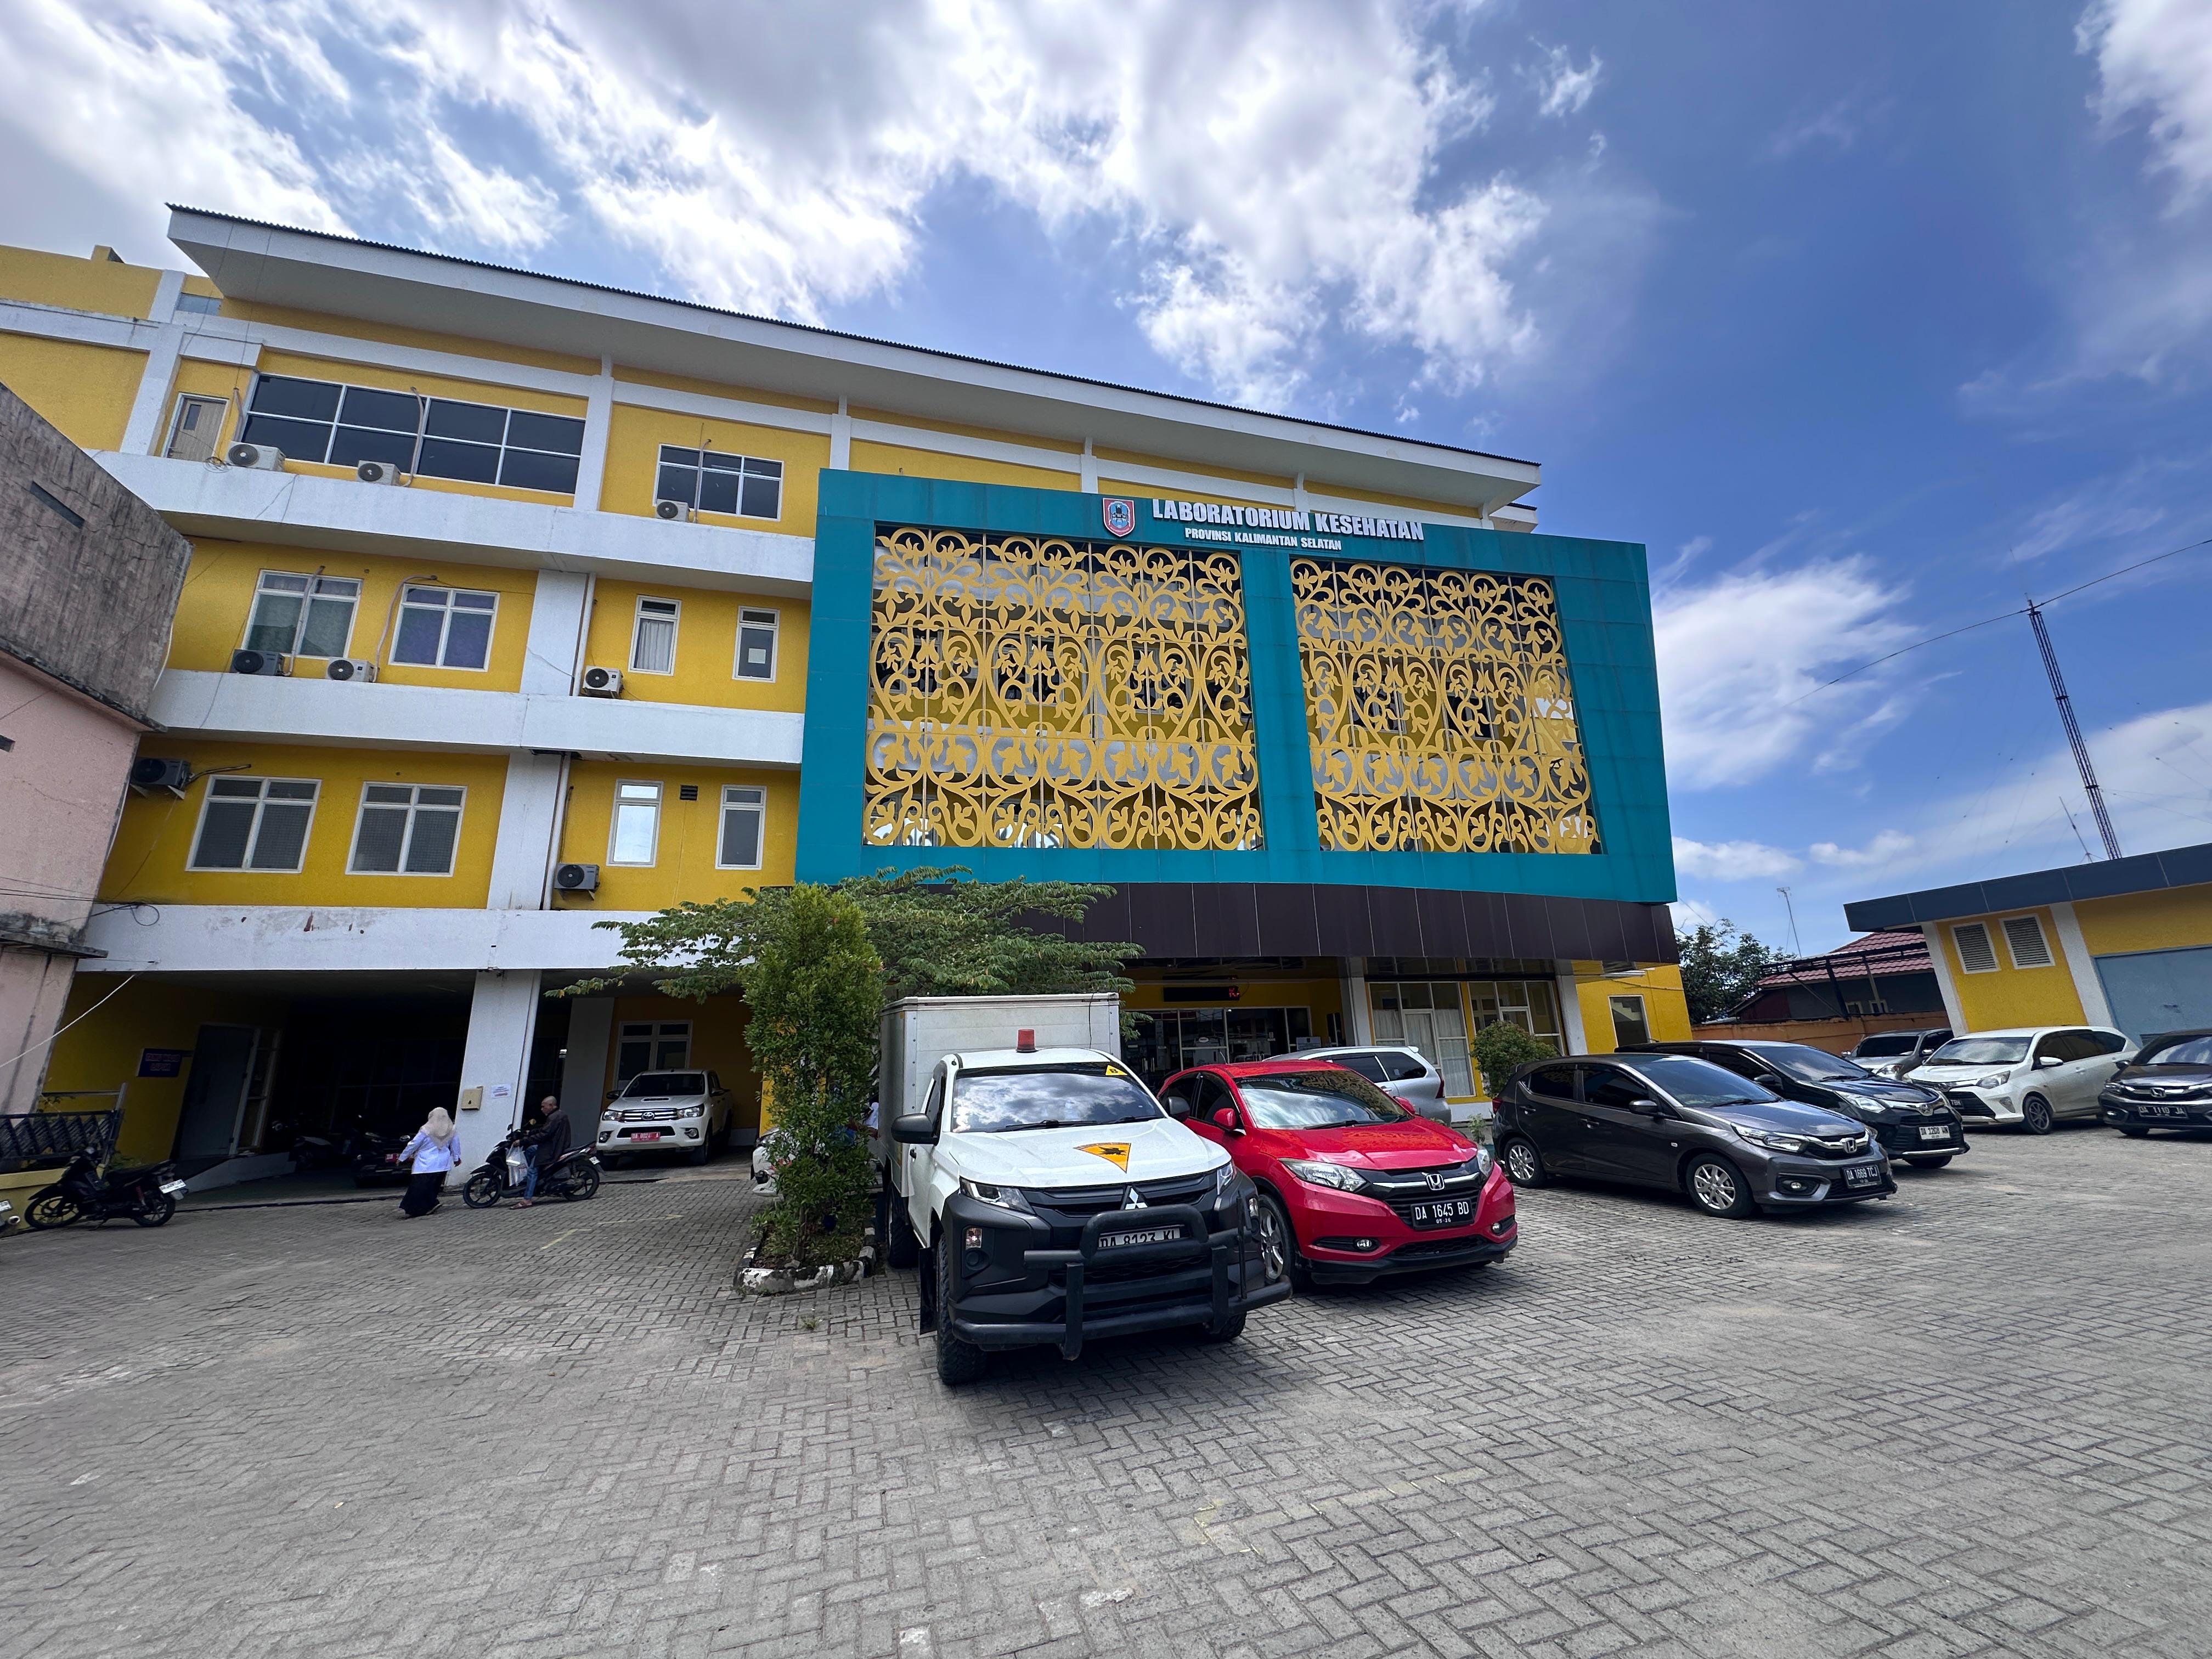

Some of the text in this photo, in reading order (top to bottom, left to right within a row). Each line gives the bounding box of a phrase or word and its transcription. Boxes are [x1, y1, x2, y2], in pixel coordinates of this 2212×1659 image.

[1153, 499, 1424, 540] LABORATORIUM KESEHATAN
[1185, 527, 1342, 550] PROVINSI KALIMANTAN SELATAN
[1846, 1169, 1854, 1180] DA
[1415, 1201, 1470, 1221] DA 1645 BD
